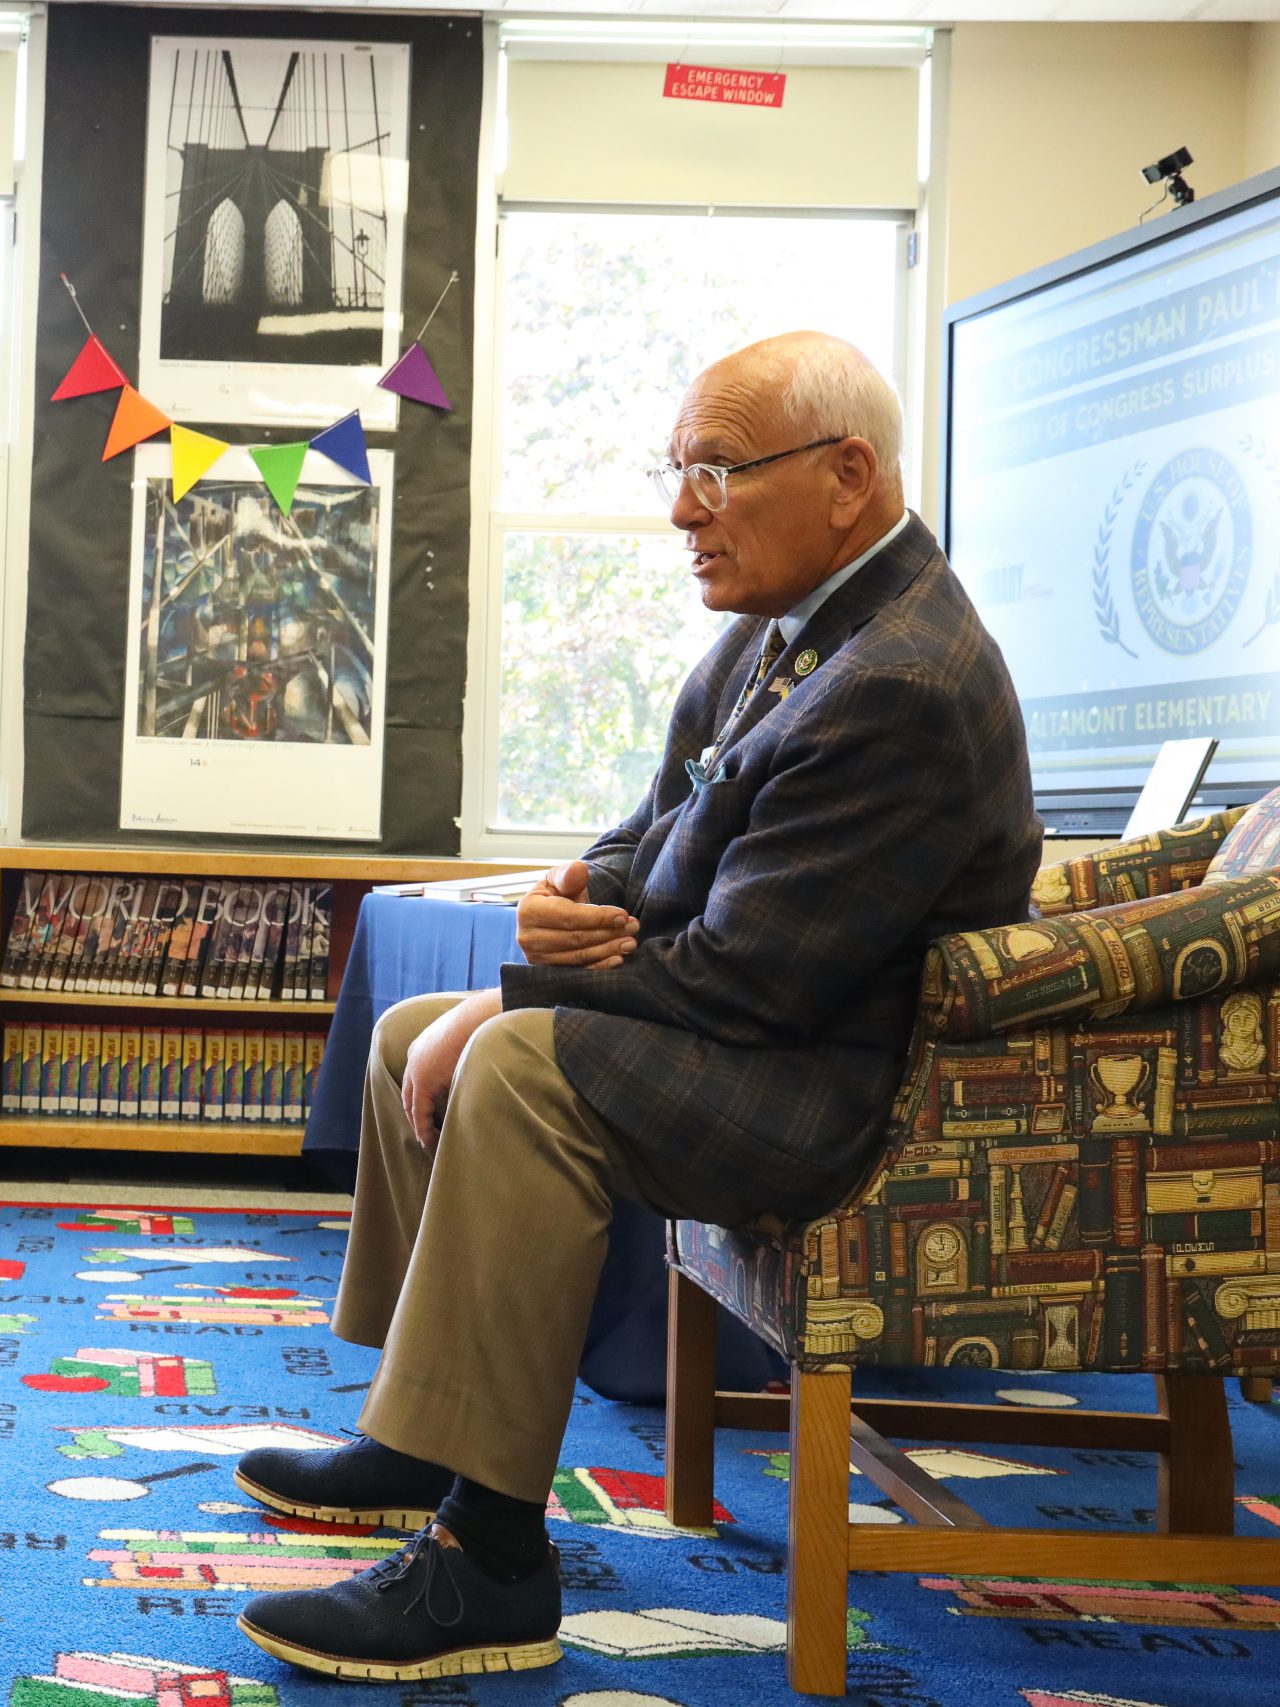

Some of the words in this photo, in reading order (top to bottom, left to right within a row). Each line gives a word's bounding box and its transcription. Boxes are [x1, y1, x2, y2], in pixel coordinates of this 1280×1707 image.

[687, 69, 764, 88] EMERGENCY
[672, 82, 719, 100] ESCAPE
[723, 87, 775, 104] WINDOW
[1011, 303, 1187, 391] CONGRESSMAN
[1198, 277, 1264, 332] PAUL
[1047, 411, 1072, 440] OF
[1075, 378, 1175, 431] CONGRESS
[1182, 348, 1275, 401] SURPLUS
[1030, 705, 1128, 738] ALTAMONT
[1134, 690, 1272, 732] ELEMENTARY
[24, 875, 189, 922] WORLD
[197, 885, 332, 927] BOOK
[1075, 1085, 1083, 1120] ITALIAN
[245, 1273, 340, 1283] REA
[129, 1323, 264, 1337] READ
[153, 1404, 311, 1420] READ
[136, 1597, 240, 1617] RE
[1023, 1626, 1252, 1659] READ
